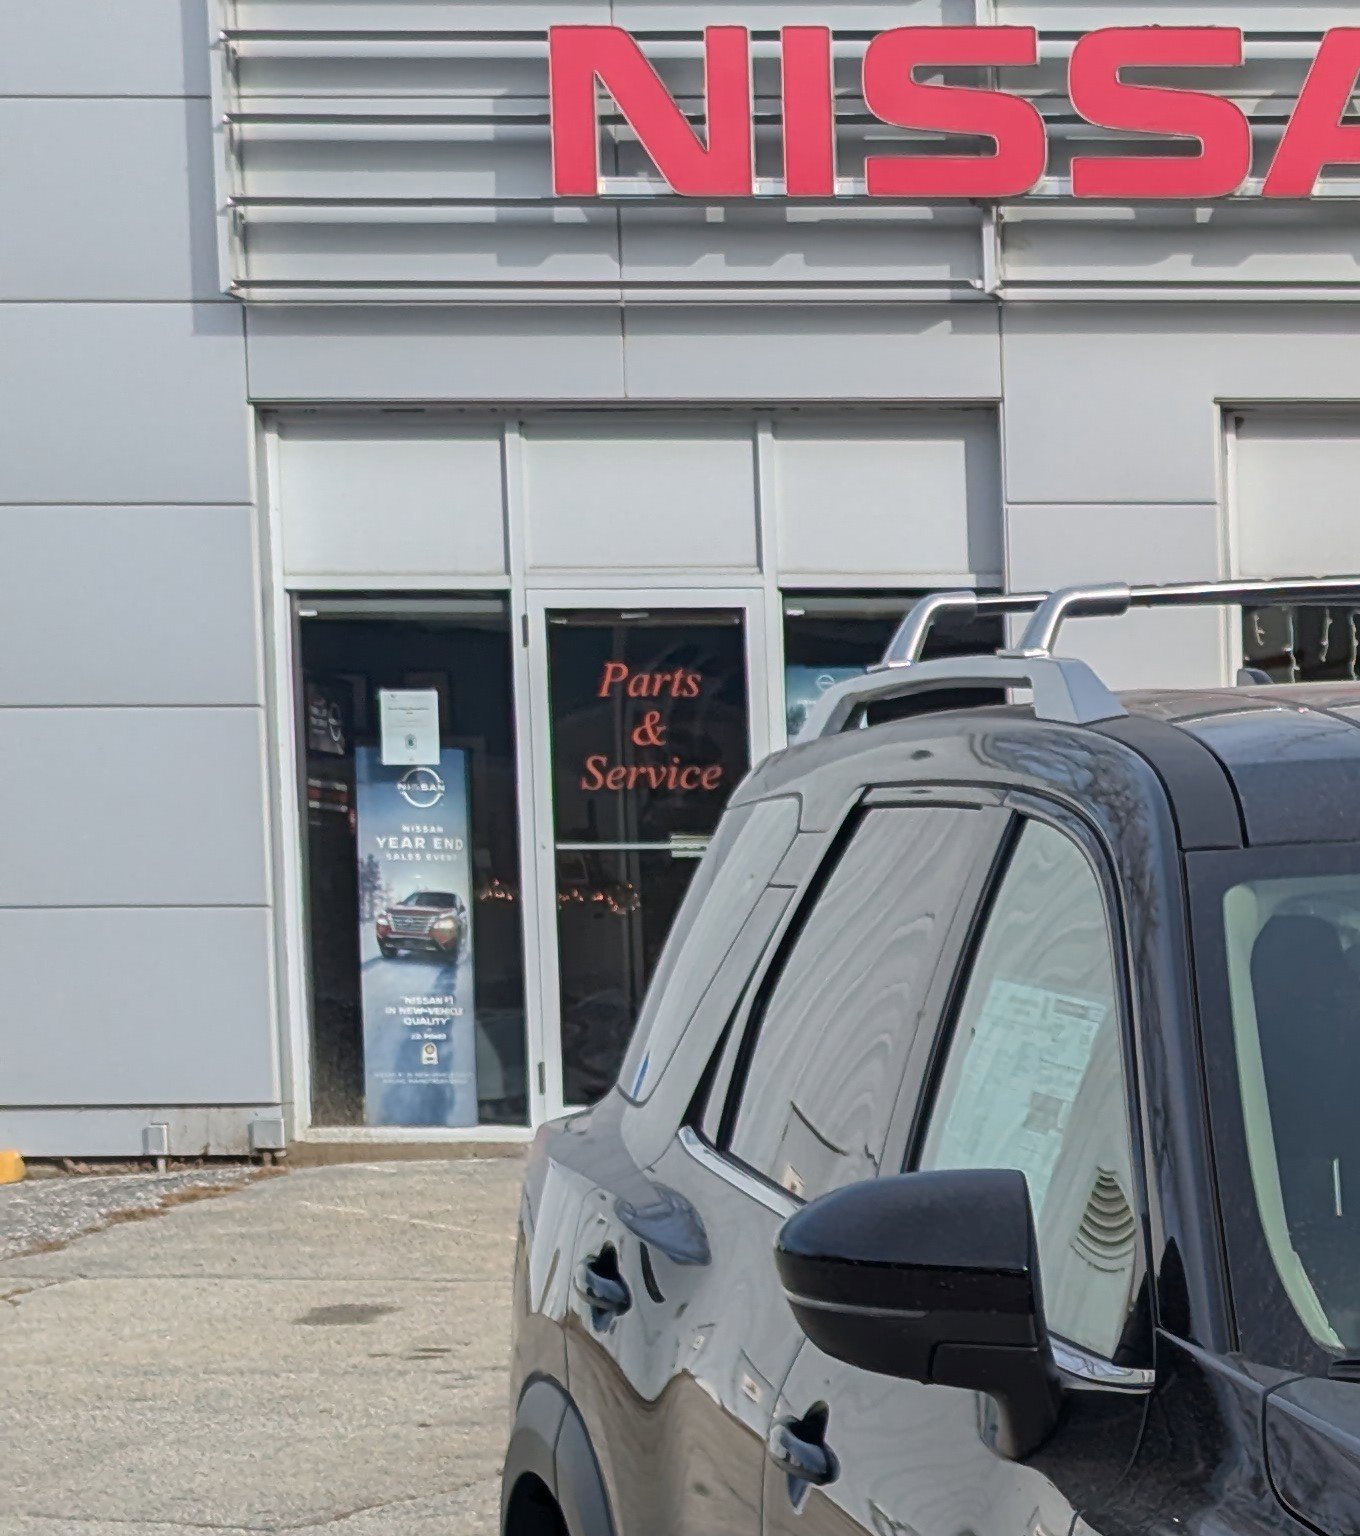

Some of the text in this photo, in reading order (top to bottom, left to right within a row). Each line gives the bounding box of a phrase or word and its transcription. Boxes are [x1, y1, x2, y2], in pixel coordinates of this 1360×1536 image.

[597, 660, 702, 698] Parts
[632, 709, 668, 747] &
[580, 754, 723, 791] Service
[401, 824, 444, 833] NISSAN
[376, 837, 464, 850] YEAR END
[385, 853, 421, 861] SALES
